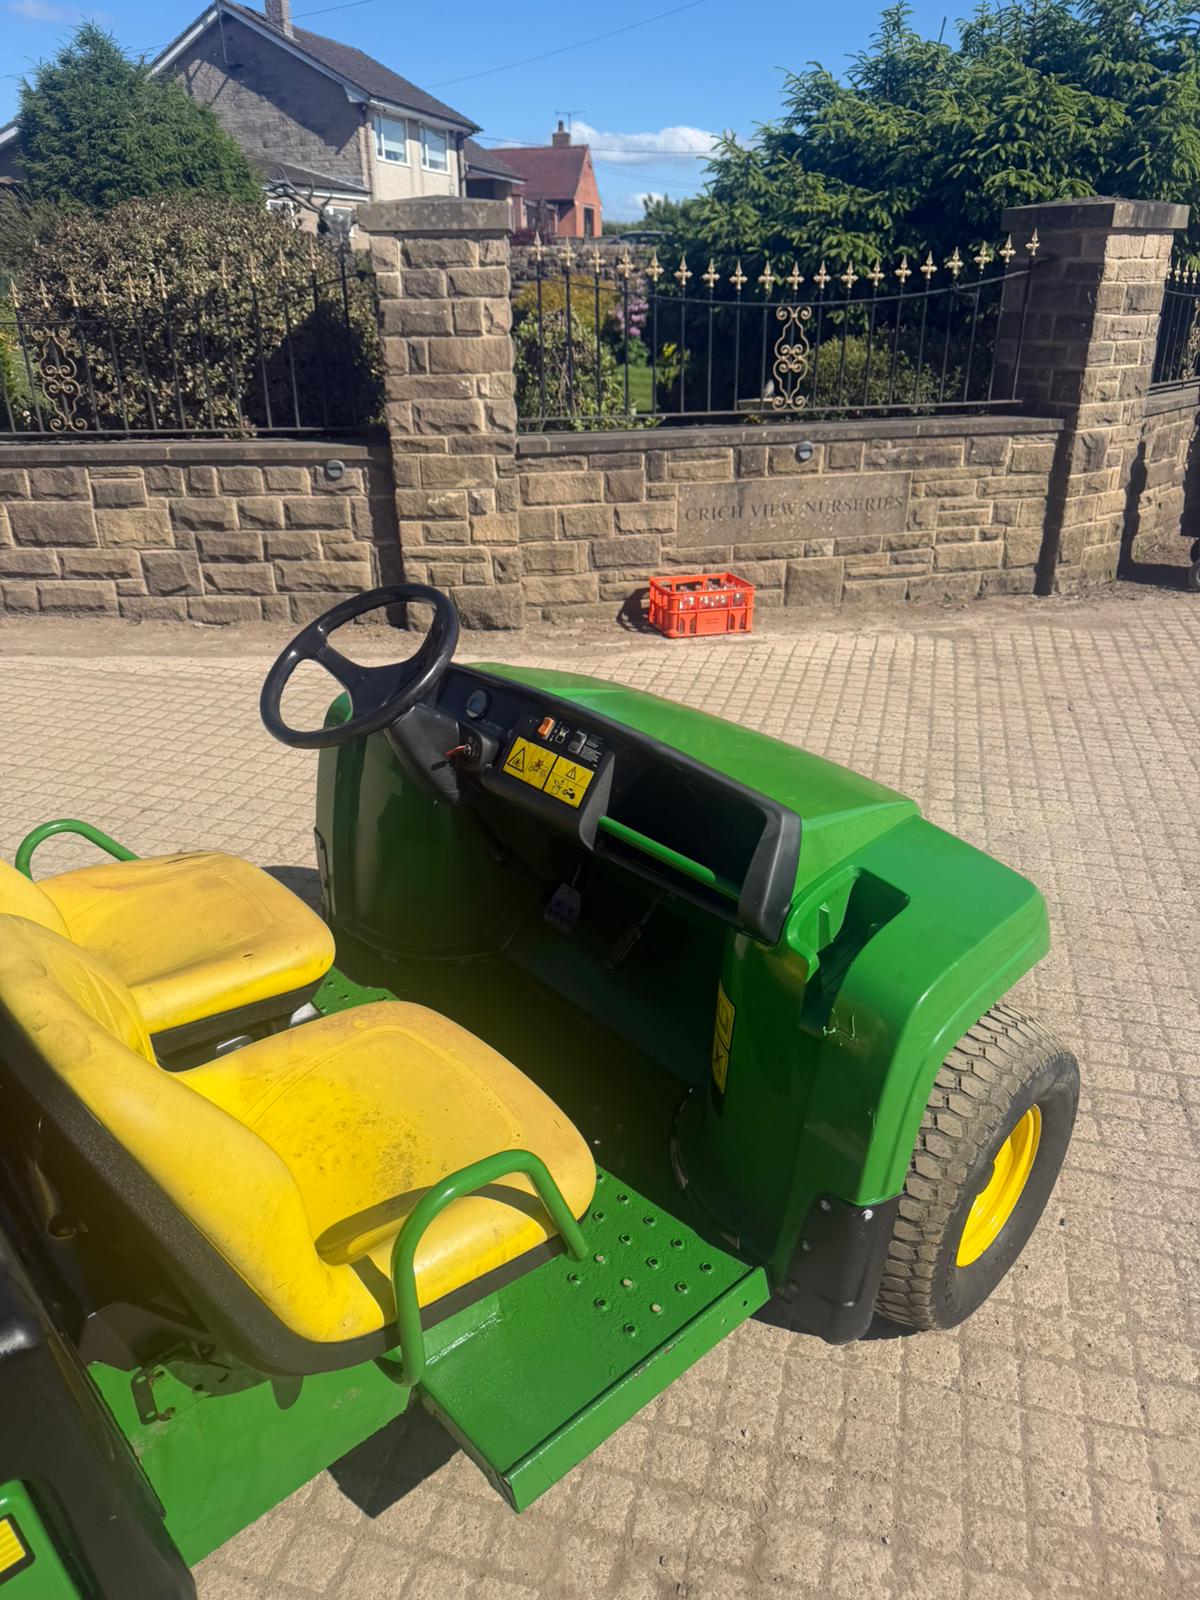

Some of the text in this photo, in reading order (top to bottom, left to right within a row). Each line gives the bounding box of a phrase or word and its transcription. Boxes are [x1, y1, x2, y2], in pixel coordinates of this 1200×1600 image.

[685, 496, 903, 521] CRICH VIEW NURSERIES
